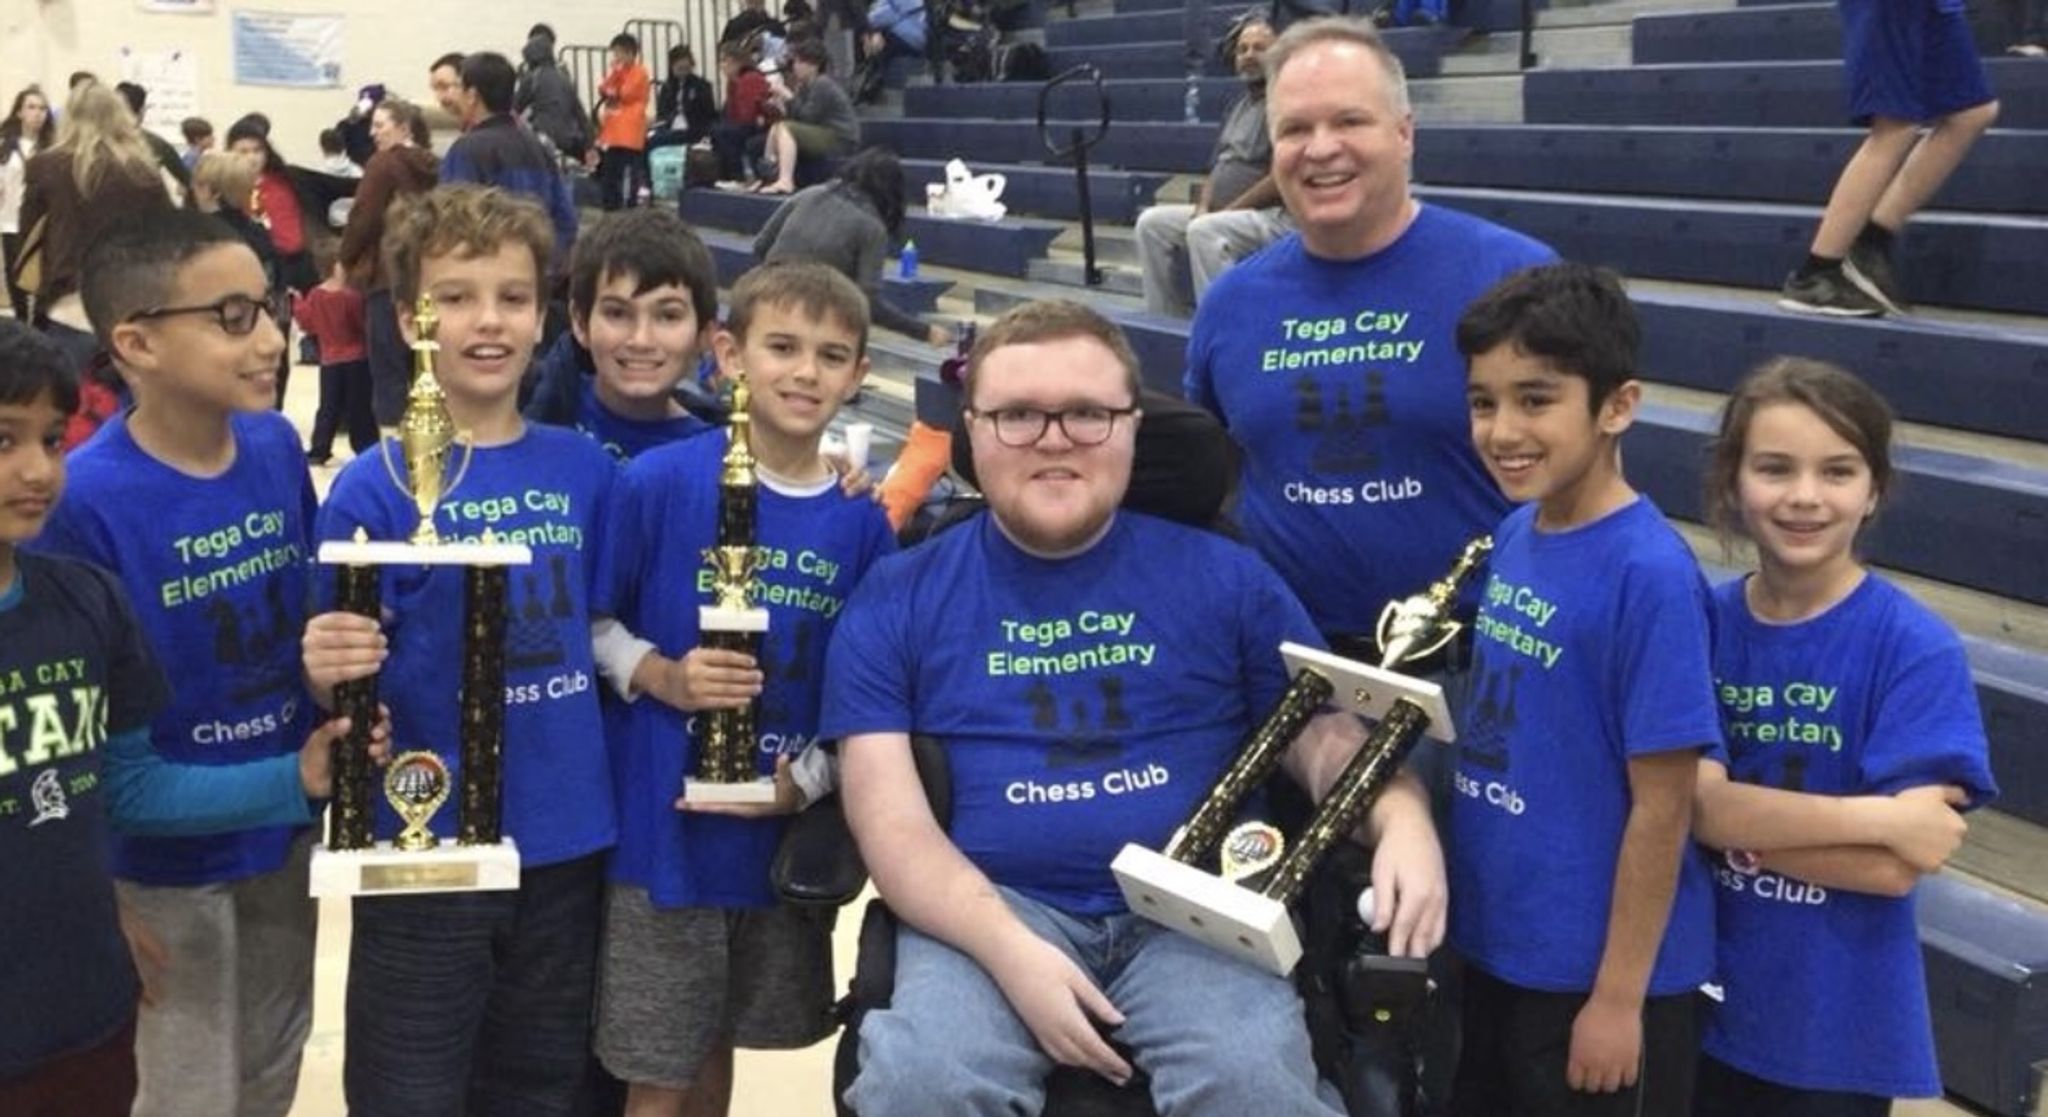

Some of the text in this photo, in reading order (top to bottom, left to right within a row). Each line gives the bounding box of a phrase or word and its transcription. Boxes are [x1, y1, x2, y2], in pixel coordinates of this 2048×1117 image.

[1282, 311, 1409, 341] Tega Cay
[1262, 340, 1424, 371] Elementary
[441, 489, 570, 522] Tega Cay
[1284, 476, 1422, 504] Chess Club
[174, 510, 284, 564] Tega Cay
[162, 544, 300, 607] Elementary
[797, 550, 840, 586] Cay
[1515, 587, 1558, 627] Cay
[1001, 611, 1135, 647] Tega Cay
[36, 659, 85, 684] CAY
[988, 643, 1156, 676] Elementary
[547, 670, 589, 699] Club
[1784, 682, 1837, 712] Cay
[192, 713, 277, 744] Chess
[1006, 763, 1169, 804] Chess Club
[1753, 876, 1826, 904] Club
